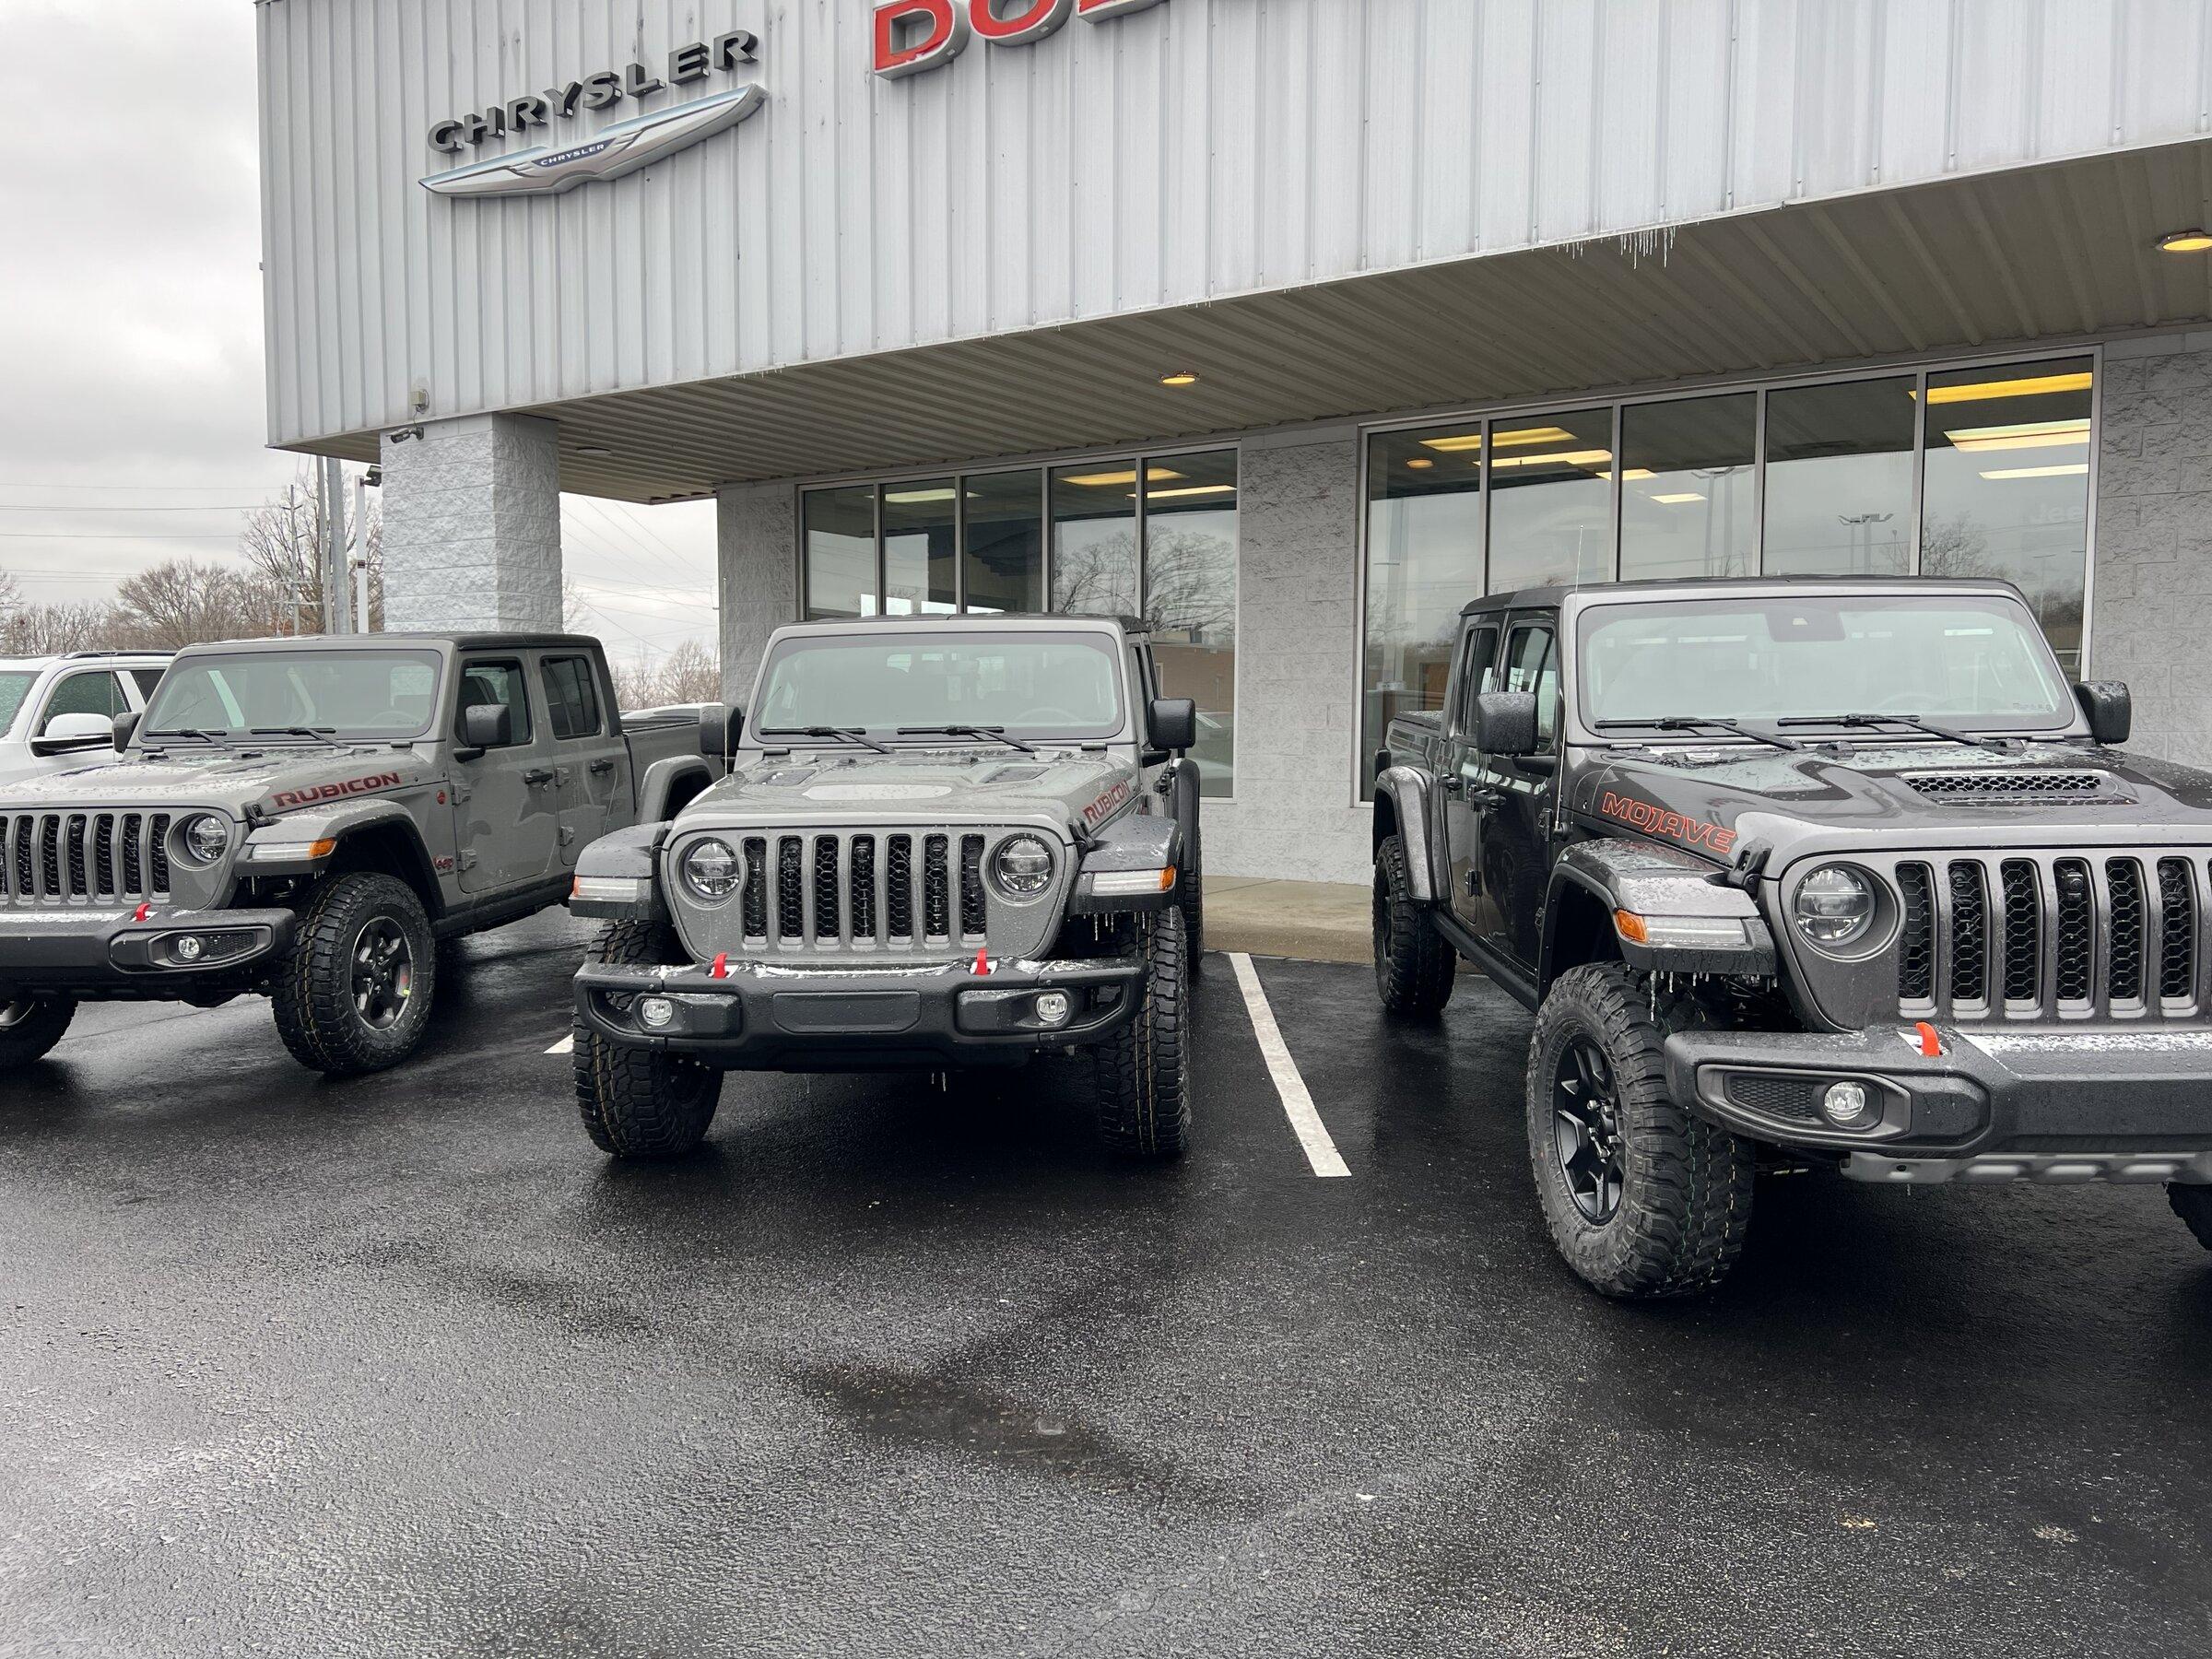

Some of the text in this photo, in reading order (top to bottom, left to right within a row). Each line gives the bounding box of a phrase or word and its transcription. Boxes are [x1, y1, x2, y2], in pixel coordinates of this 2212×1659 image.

[874, 0, 1163, 79] DO
[428, 29, 759, 154] CHRYSLER
[540, 143, 606, 167] CHRYSLER
[272, 772, 401, 807] RUBICON
[1082, 779, 1131, 825] RUBICON
[1602, 792, 1737, 853] MOJAVE
